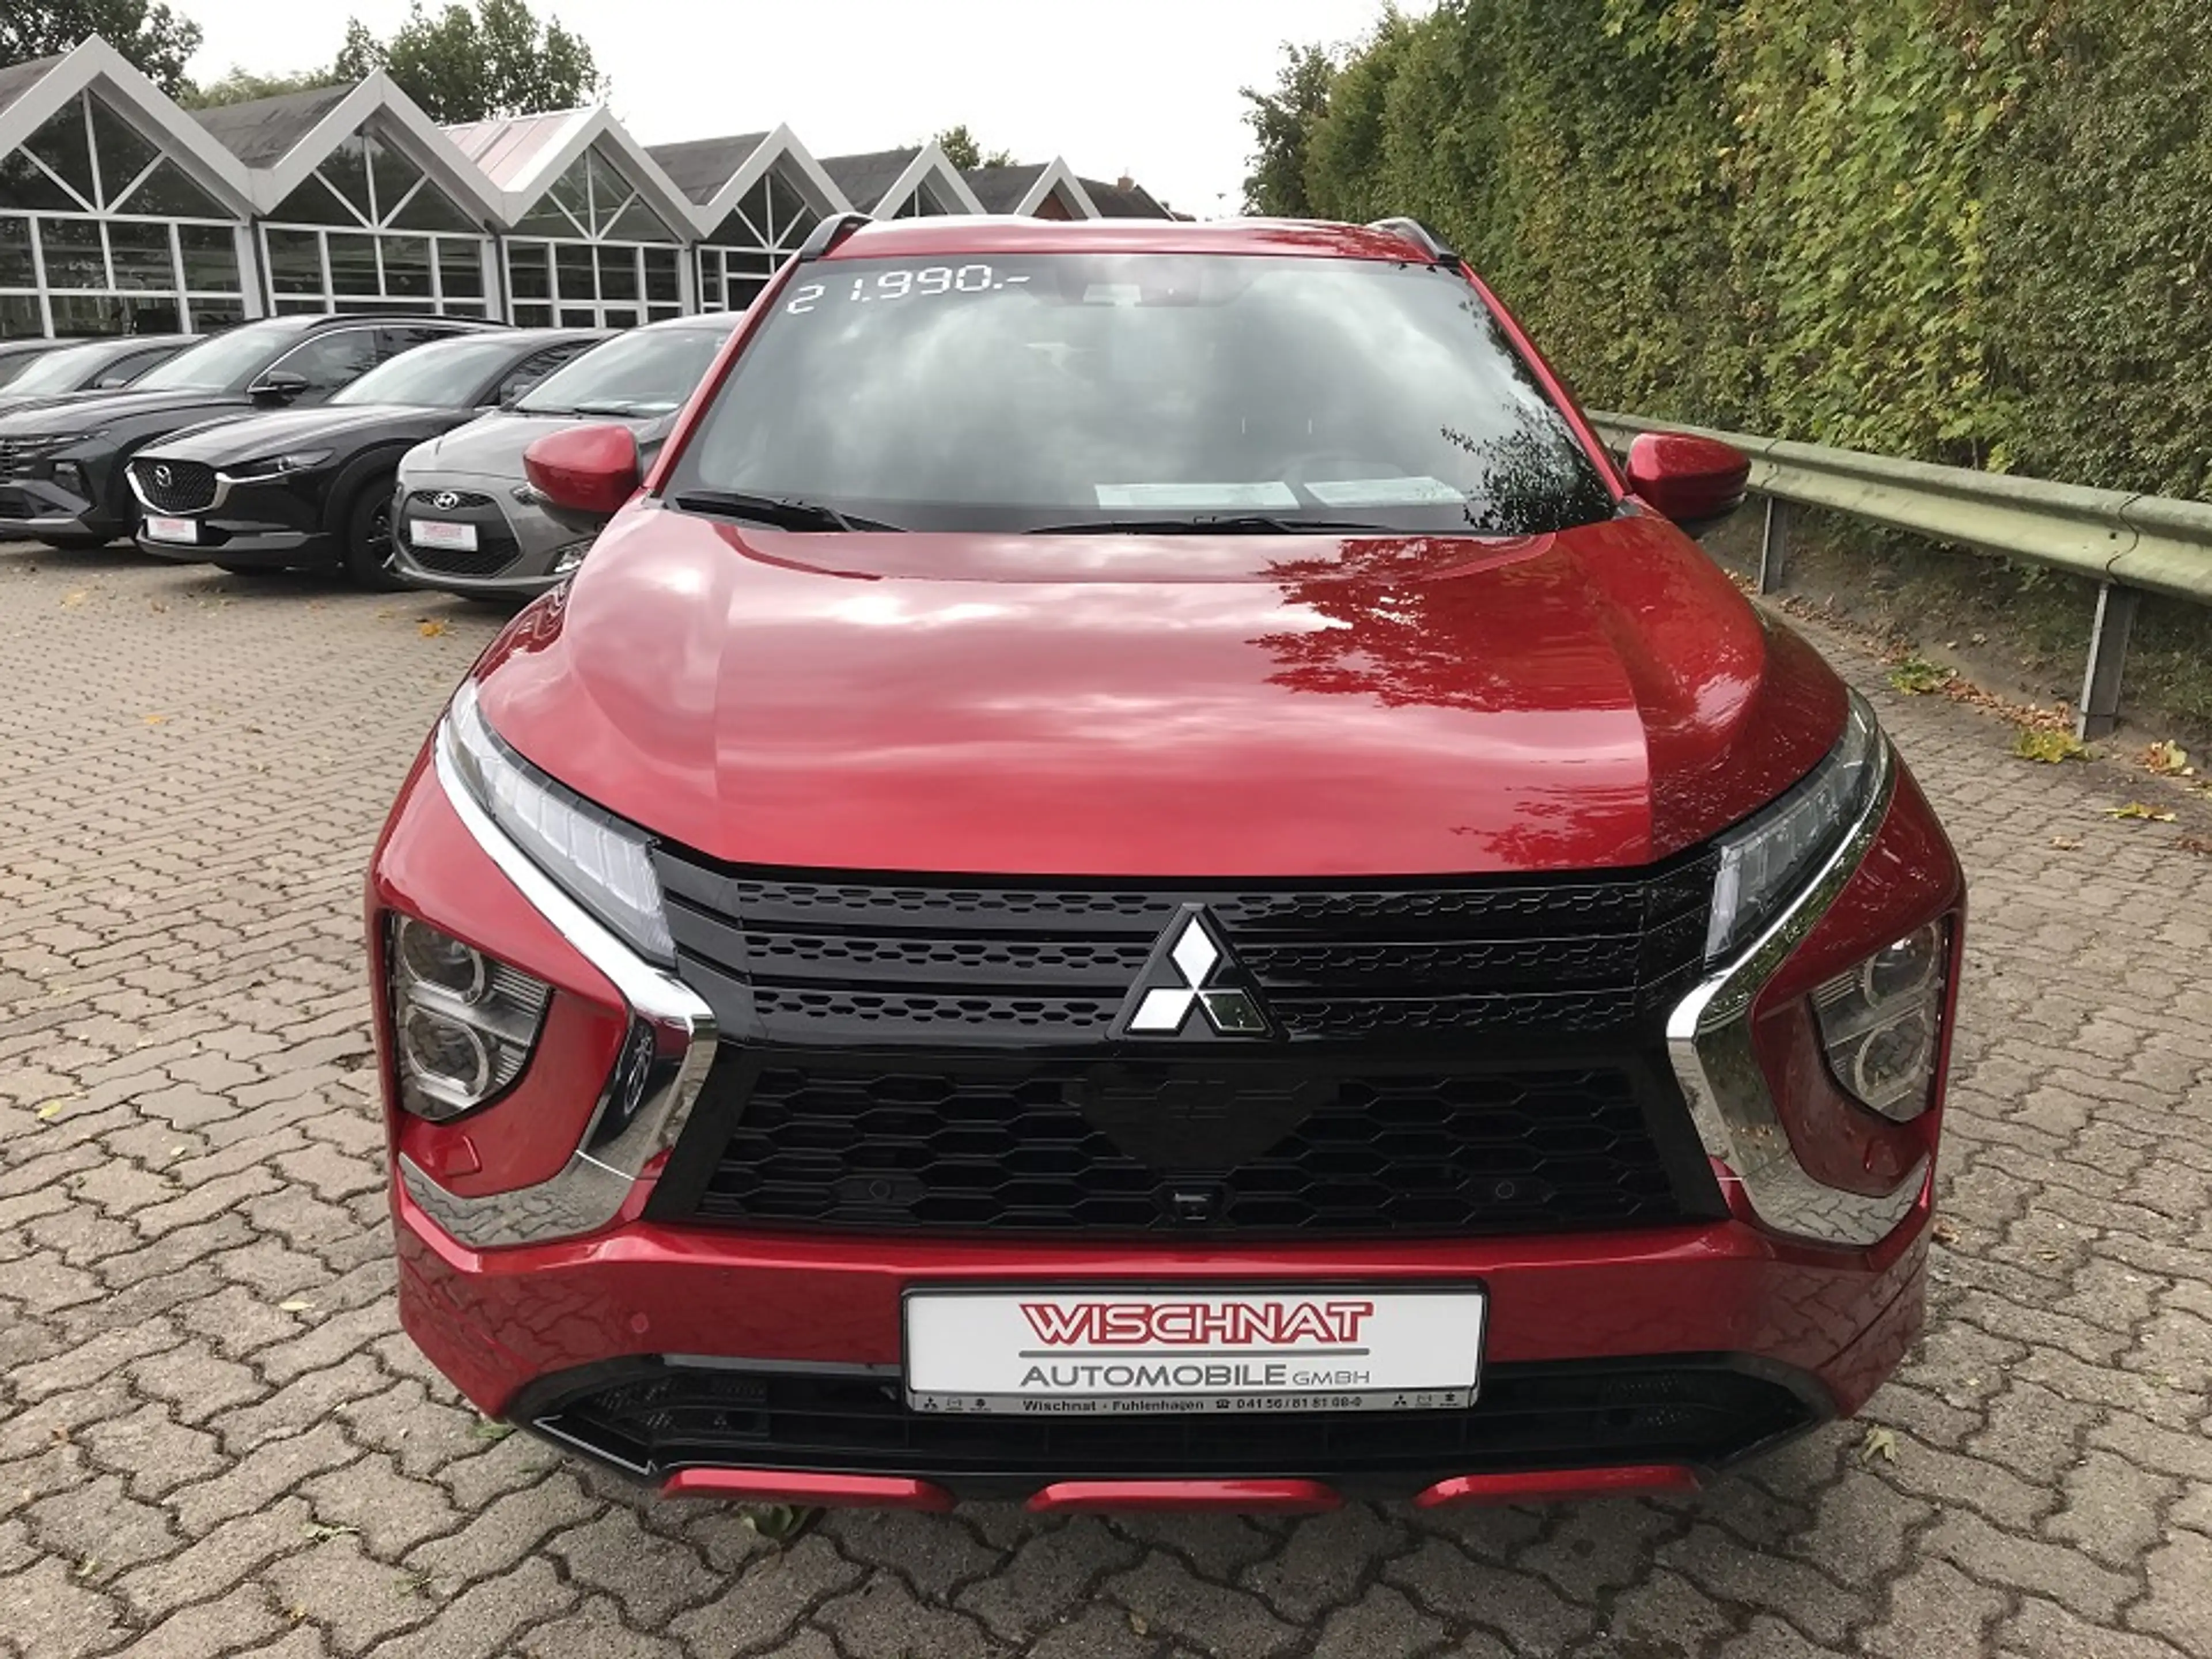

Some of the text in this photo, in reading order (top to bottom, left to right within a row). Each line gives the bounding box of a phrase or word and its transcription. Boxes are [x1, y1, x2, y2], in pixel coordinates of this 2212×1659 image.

[1018, 1301, 1374, 1345] WISCHNAT
[1019, 1364, 1370, 1387] AUTOMOBILE GMBH
[1022, 1400, 1096, 1411] Wischnat
